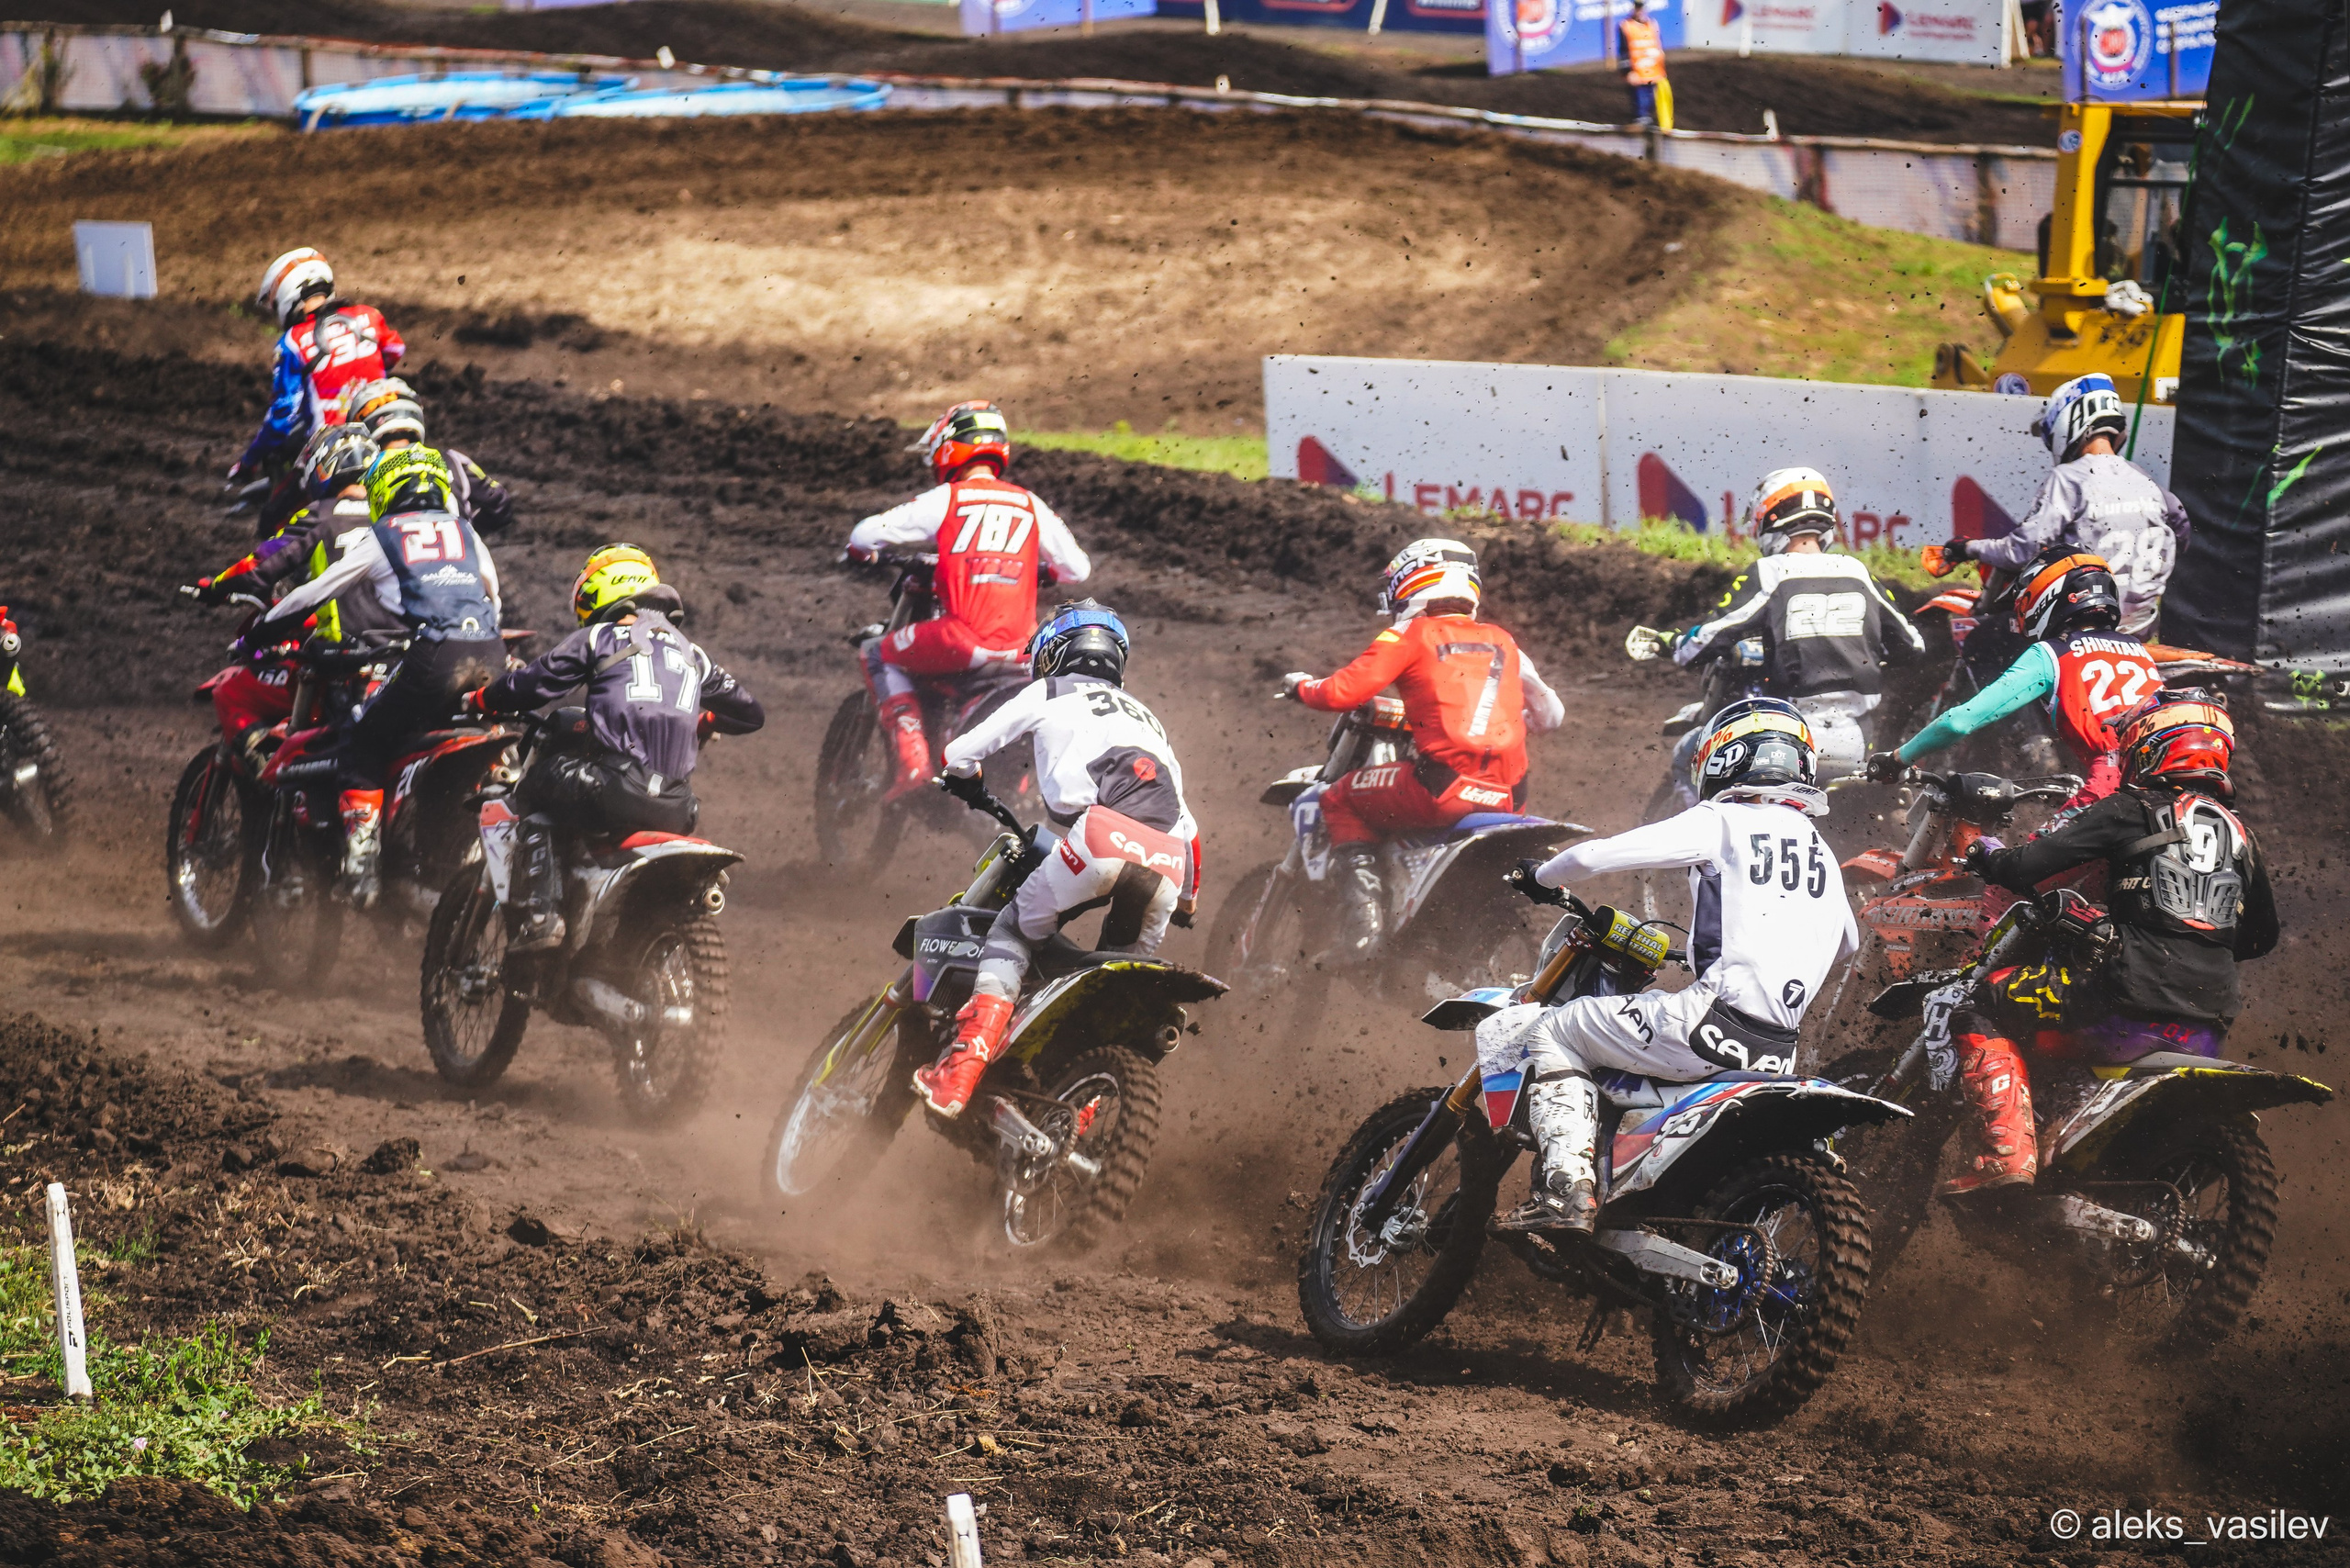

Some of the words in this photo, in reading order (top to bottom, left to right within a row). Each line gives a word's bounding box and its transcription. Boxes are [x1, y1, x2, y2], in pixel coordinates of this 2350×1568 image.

[400, 520, 466, 566] 21
[950, 502, 1035, 554] 787
[2098, 526, 2172, 587] 28
[1785, 591, 1867, 641] 22
[625, 645, 700, 714] 17
[1437, 642, 1506, 737] 7
[1350, 767, 1402, 790] LEATT
[1458, 785, 1509, 806] LEATT
[1791, 786, 1819, 796] LEATT
[1749, 834, 1827, 899] 555
[2188, 823, 2218, 873] 9
[1613, 922, 1664, 953] RENTHAL
